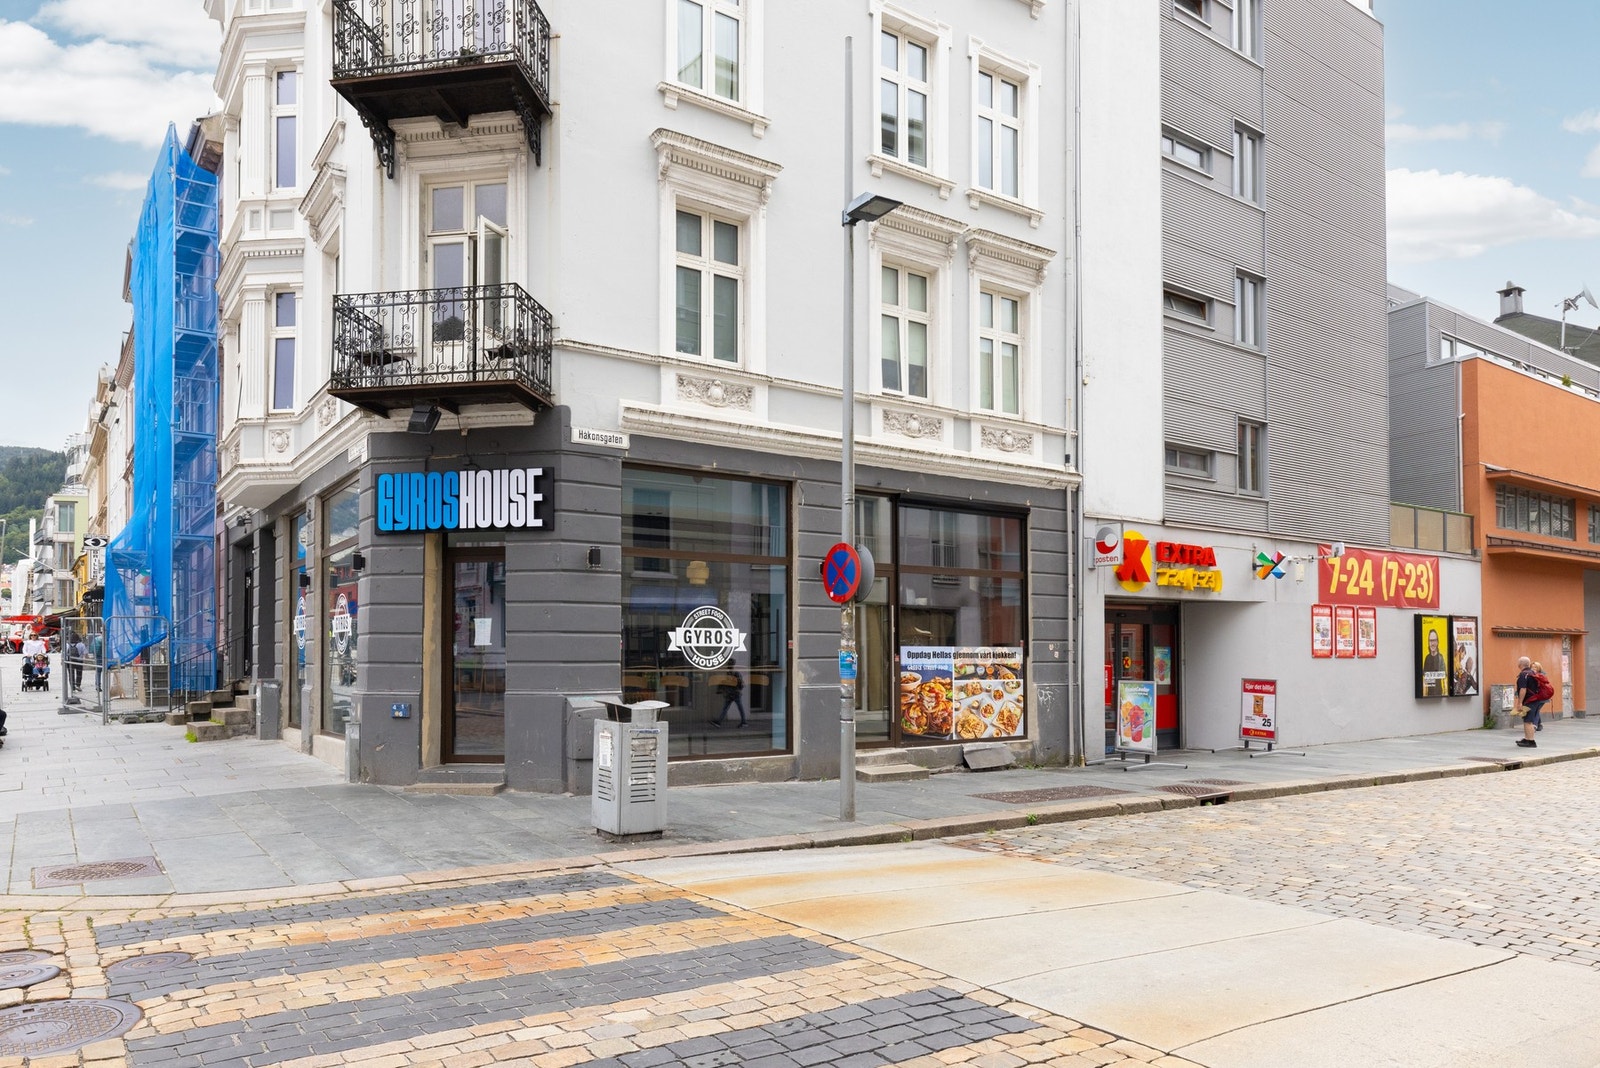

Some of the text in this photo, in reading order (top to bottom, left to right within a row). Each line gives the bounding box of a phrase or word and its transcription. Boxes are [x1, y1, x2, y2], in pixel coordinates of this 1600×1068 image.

[1095, 555, 1119, 564] posten
[1156, 541, 1217, 567] EXTRA
[1327, 556, 1434, 604] 7-24 (7-23)
[693, 608, 724, 620] STREET FOOD
[683, 629, 733, 645] GYROS
[692, 654, 725, 667] HOUSE
[906, 650, 931, 660] Oppdag
[932, 650, 952, 659] Hellas
[953, 651, 979, 660] gjennom
[1262, 718, 1272, 728] 25
